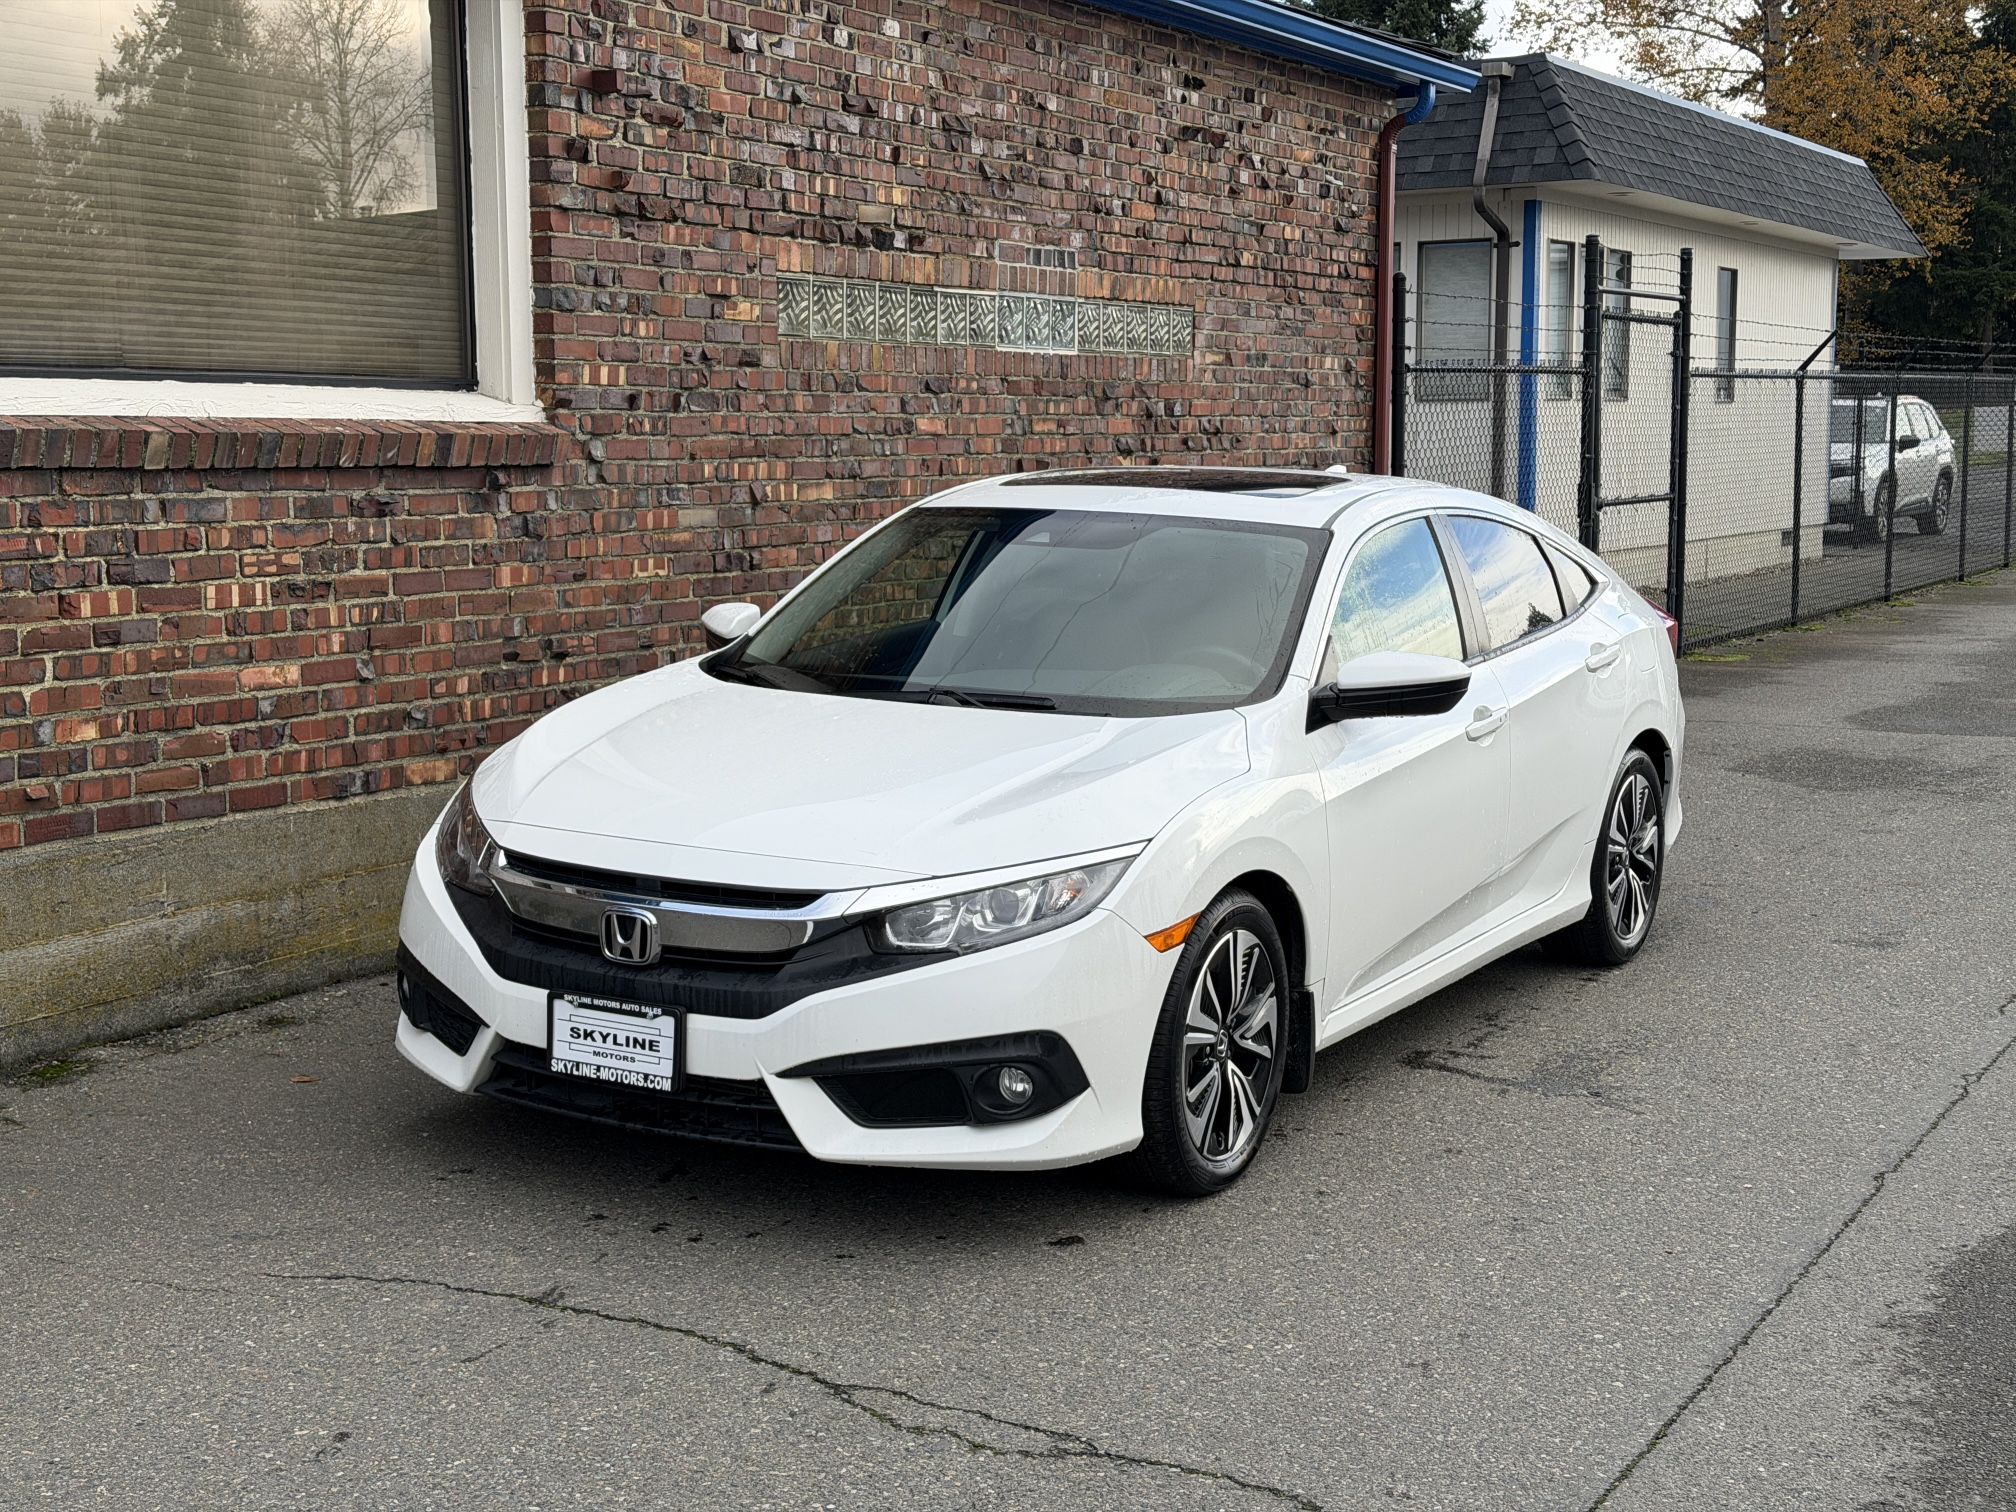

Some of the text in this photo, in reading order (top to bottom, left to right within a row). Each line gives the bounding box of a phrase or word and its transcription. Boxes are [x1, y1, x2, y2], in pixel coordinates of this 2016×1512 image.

[563, 994, 662, 1015] SKYLINE MOTORS AUTO SALES
[569, 1026, 661, 1053] SKYLINE
[592, 1050, 636, 1064] MOTORS
[550, 1058, 672, 1092] SKYLINE-MOTORS.COM
